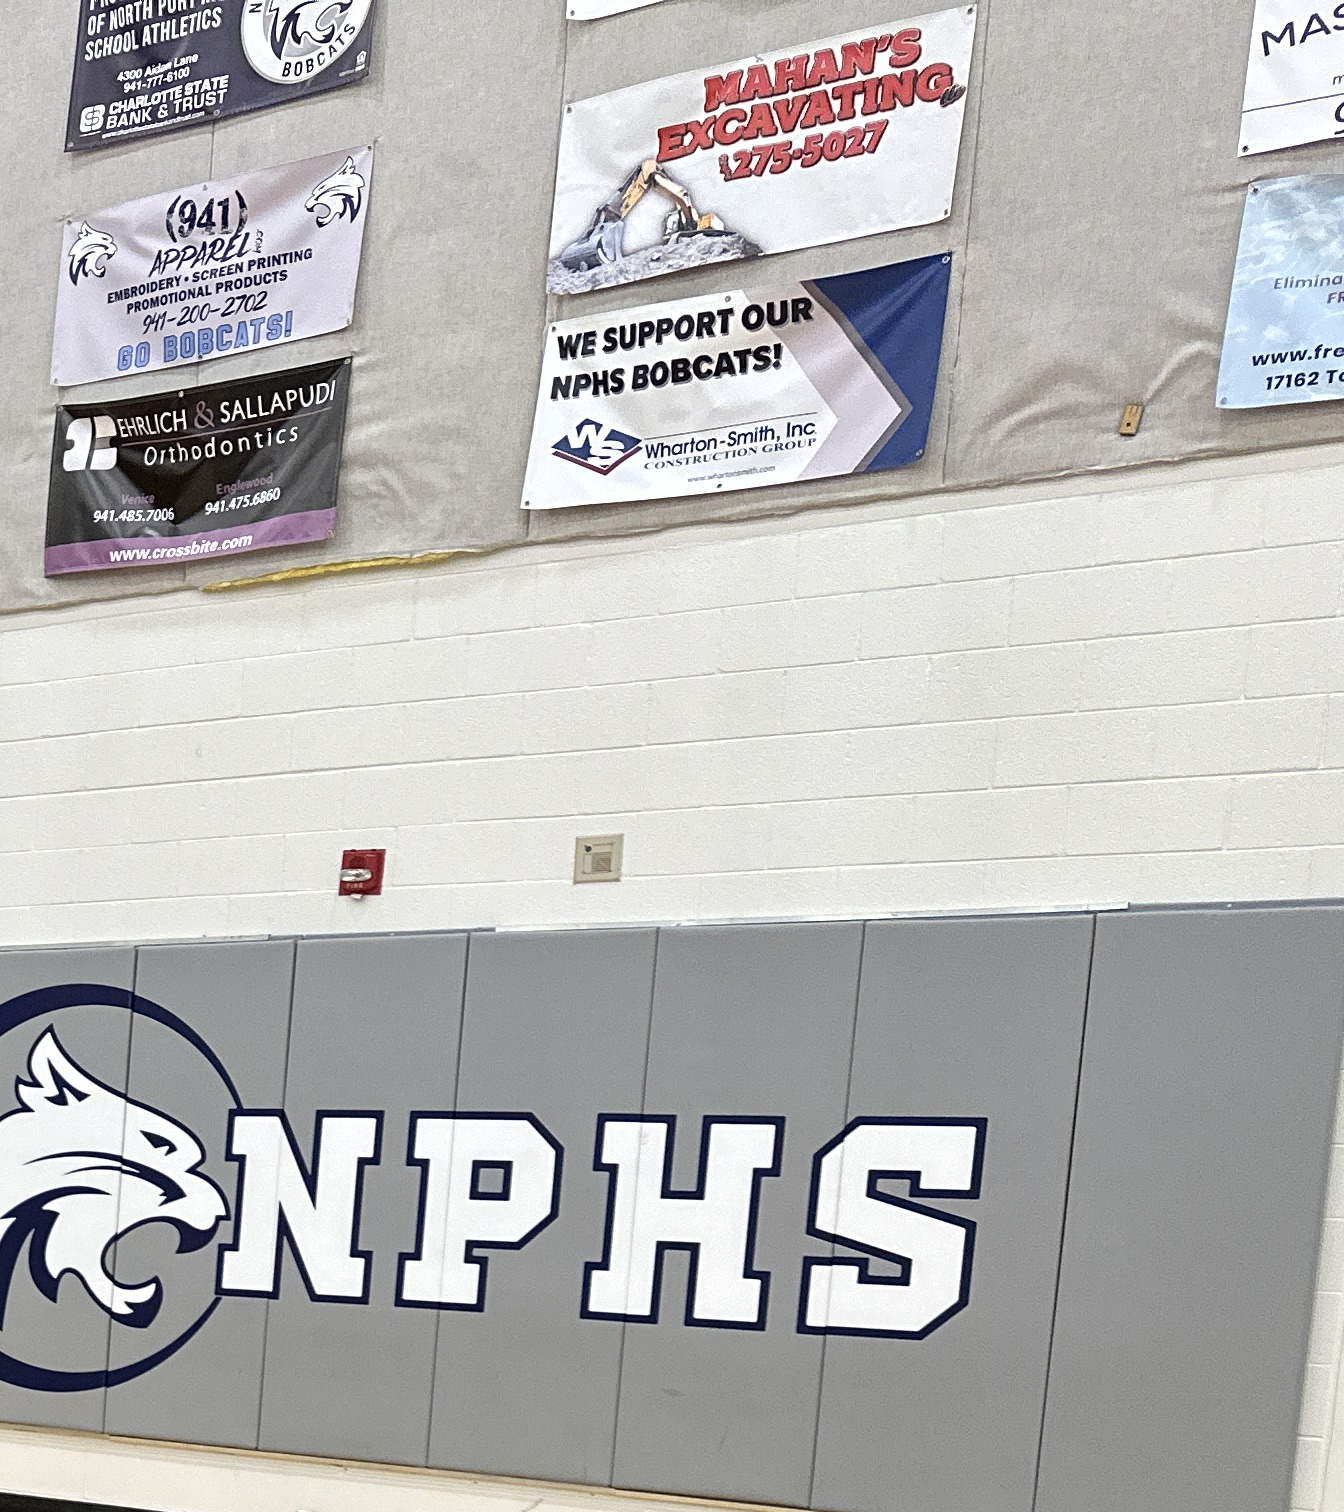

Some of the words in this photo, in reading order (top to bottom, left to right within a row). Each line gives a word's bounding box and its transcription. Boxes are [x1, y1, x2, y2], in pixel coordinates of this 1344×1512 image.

[85, 31, 139, 61] SCHOOL
[142, 8, 222, 48] ATHLETICS
[87, 16, 106, 36] OF
[110, 0, 152, 30] NORTH
[117, 68, 142, 82] 4300
[174, 54, 198, 67] Lane
[282, 23, 355, 77] BOBCATS
[703, 27, 922, 112] MAHAN'S
[109, 85, 182, 115] CHARLOTTE
[184, 75, 229, 96] STATE
[124, 67, 190, 93] 941-777-6100
[106, 107, 152, 130] BANK
[158, 104, 168, 118] &
[174, 89, 227, 114] TRUST
[656, 62, 954, 163] EXCAVATING
[166, 190, 248, 243] (941)
[148, 231, 255, 278] APPAREL
[107, 275, 182, 304] EMBROIDERY
[192, 262, 243, 283] SCREEN
[248, 248, 313, 271] PRINTING
[127, 283, 212, 314] PROMOTIONAL
[216, 269, 288, 294] PRODUCTS
[142, 291, 268, 334] 941-200-2702
[557, 330, 597, 360] WE
[603, 307, 734, 353] SUPPORT
[741, 296, 814, 330] OUR
[117, 340, 150, 371] GO
[164, 310, 294, 363] BOBCATS!
[550, 366, 625, 402] NPHS
[631, 342, 784, 392] BOBCATS!
[1266, 372, 1319, 390] 17162
[118, 409, 187, 439] EHRLICH
[193, 400, 215, 429] &
[220, 379, 336, 424] SALLAPUDI
[144, 424, 299, 466] Orthodontics
[644, 424, 781, 460] Wharton-Smith,
[644, 445, 758, 470] CONSTRUCTION
[762, 437, 817, 455] GROUP
[121, 493, 155, 505] Venice
[205, 486, 281, 516] 941.475.6860
[216, 473, 274, 495] Englewood
[93, 507, 175, 523] 941.485.7006
[109, 533, 253, 563] www.crossbite.com
[214, 1107, 988, 1341] NPHS
